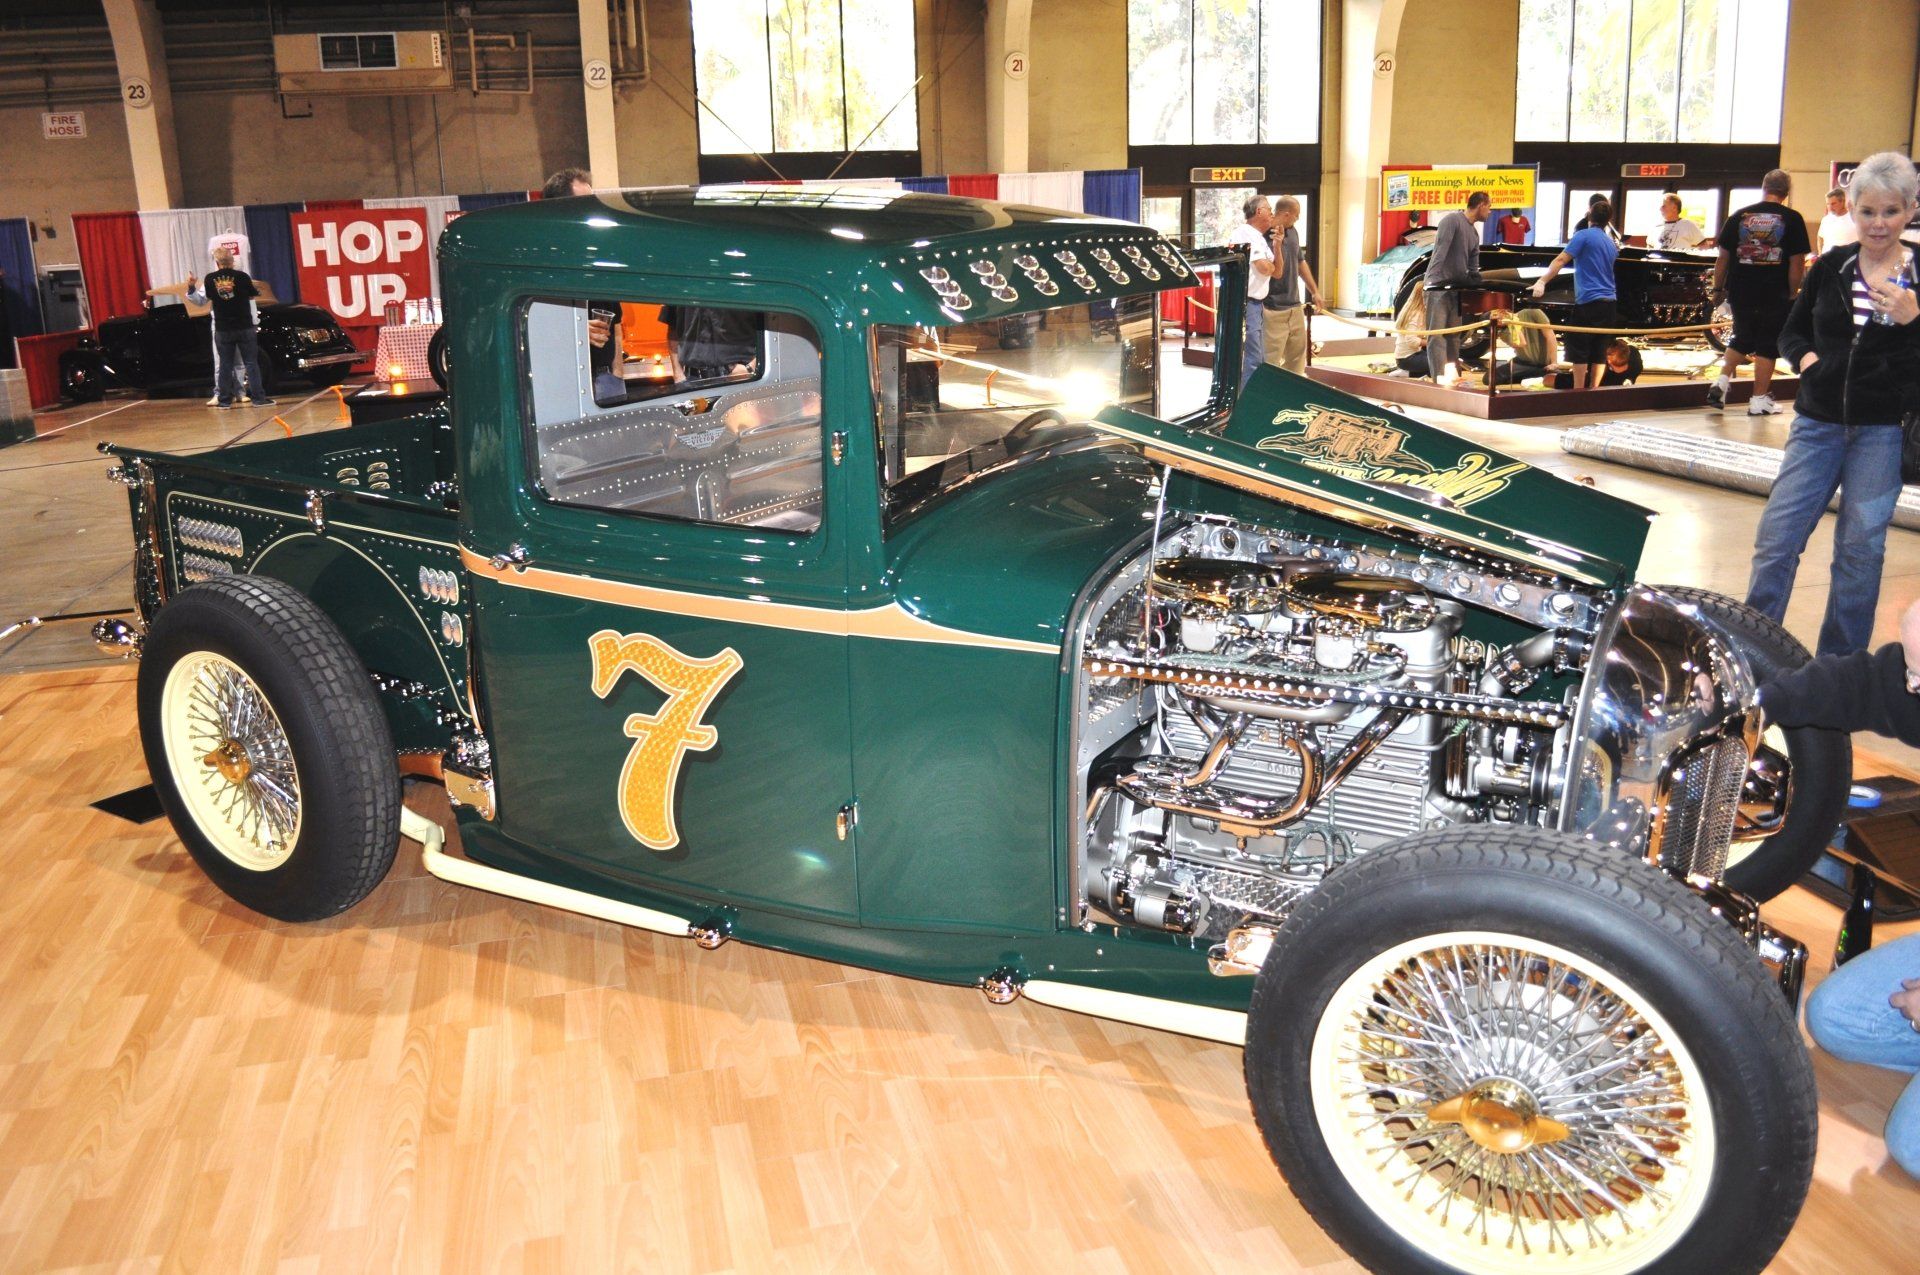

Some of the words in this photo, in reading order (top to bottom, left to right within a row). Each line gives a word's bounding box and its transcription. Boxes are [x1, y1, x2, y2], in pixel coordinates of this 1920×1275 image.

[432, 37, 440, 64] HEATER
[1012, 59, 1023, 72] 21
[1379, 59, 1392, 71] 20
[590, 66, 606, 80] 22
[128, 85, 145, 99] 23
[51, 115, 77, 125] FIRE
[49, 126, 82, 136] HOSE
[1211, 168, 1245, 181] EXIT
[1640, 165, 1669, 176] EXIT
[1411, 176, 1463, 188] Hemmings
[1466, 175, 1496, 186] Motor
[1499, 175, 1524, 186] News
[1411, 190, 1441, 205] FREE
[1444, 189, 1471, 205] GIFT
[298, 219, 424, 268] HOP
[326, 273, 407, 319] UP
[588, 629, 744, 850] 7
